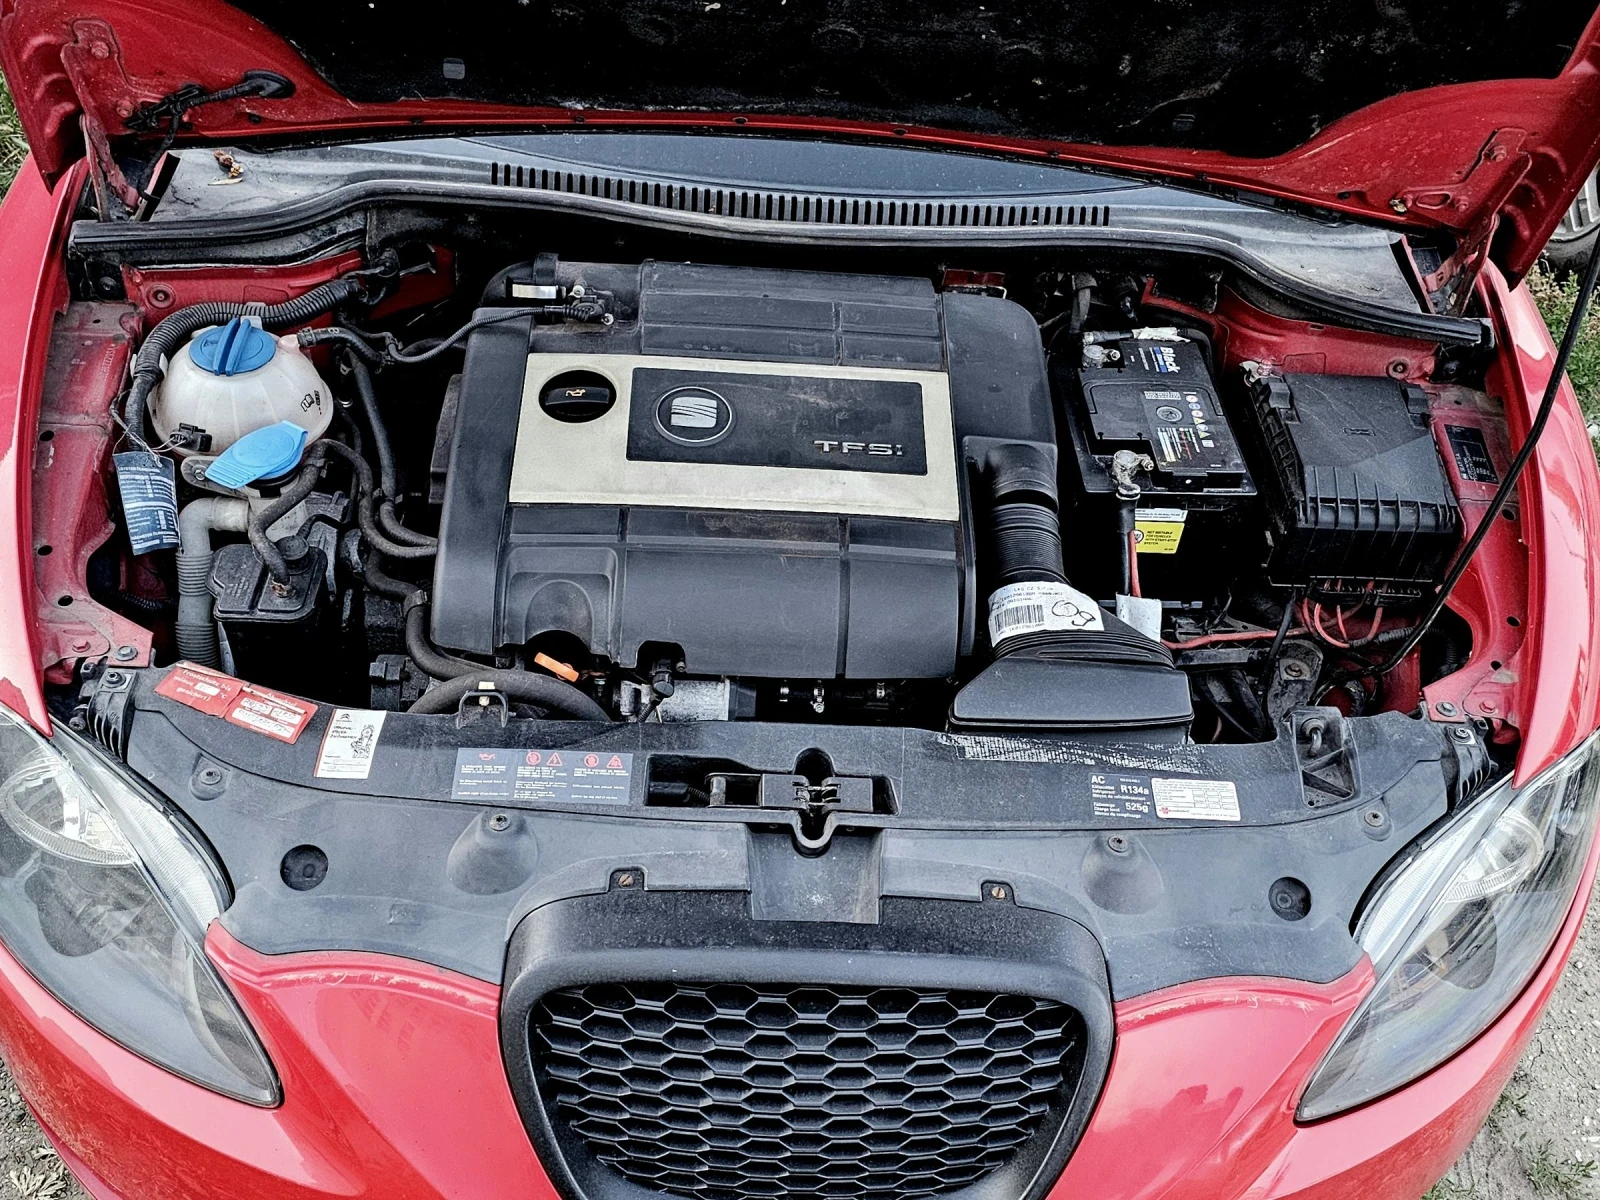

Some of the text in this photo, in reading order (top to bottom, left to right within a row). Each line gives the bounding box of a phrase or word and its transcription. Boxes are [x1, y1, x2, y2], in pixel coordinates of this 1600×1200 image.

[1160, 346, 1181, 373] Black
[173, 675, 195, 687] minus
[182, 669, 232, 692] Frostschutz bis
[1091, 775, 1106, 784] AC
[1120, 784, 1149, 795] R134a
[1125, 802, 1149, 813] 525g
